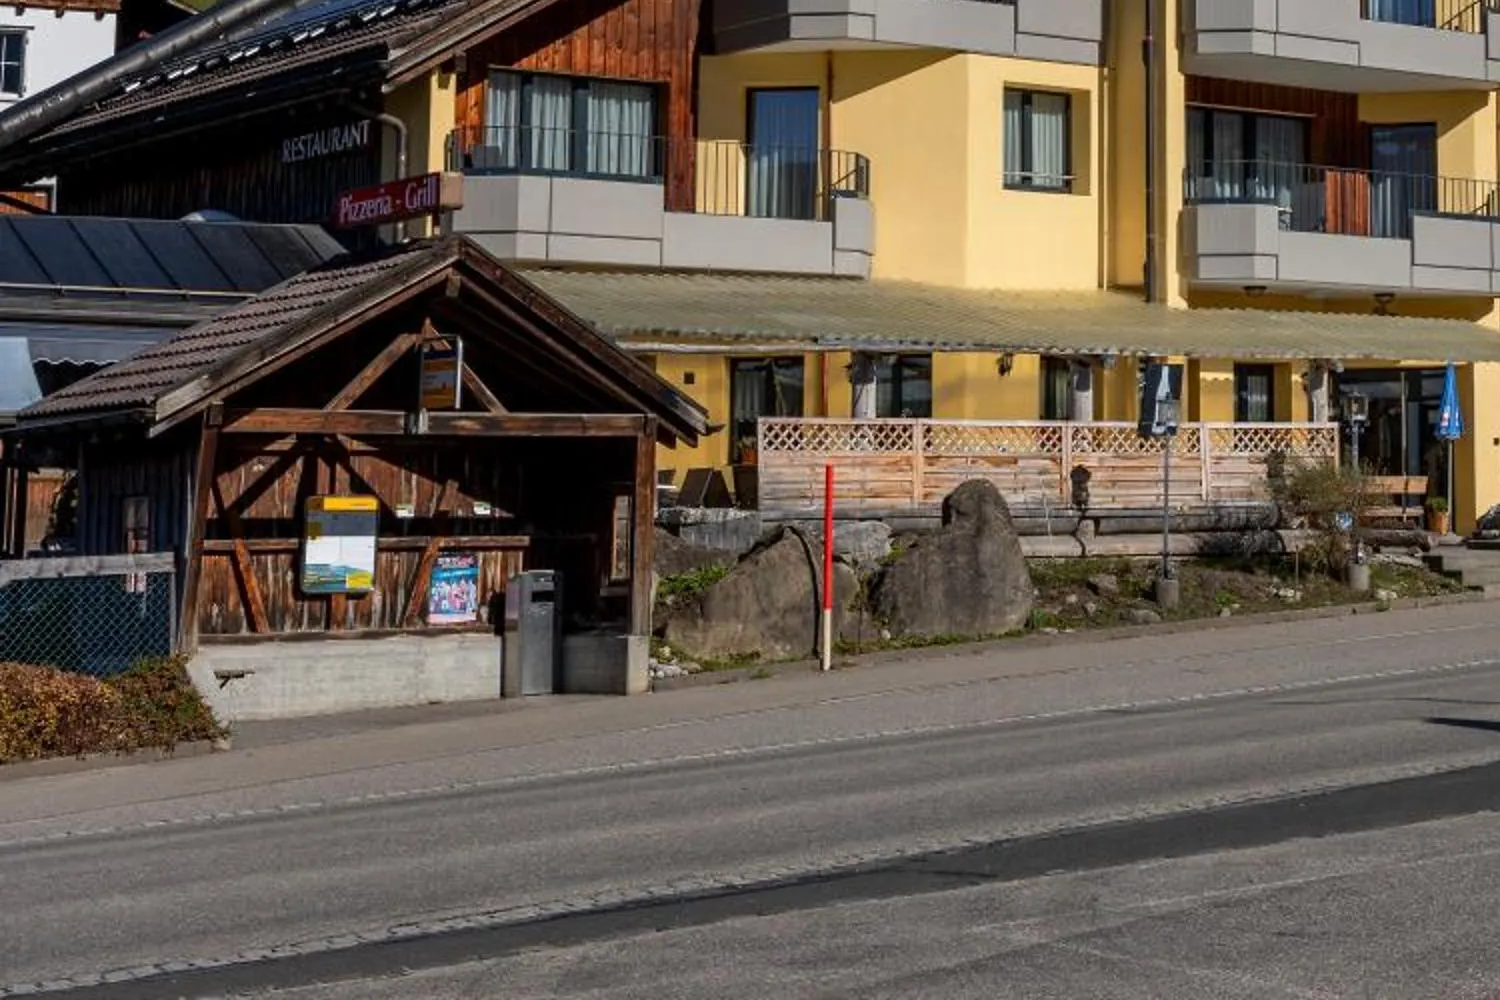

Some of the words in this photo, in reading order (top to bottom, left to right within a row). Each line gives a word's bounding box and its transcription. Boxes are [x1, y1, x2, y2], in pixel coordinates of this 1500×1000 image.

[282, 119, 371, 163] RESTAURANT
[339, 189, 393, 225] Pizzeria
[405, 175, 438, 210] Grill
